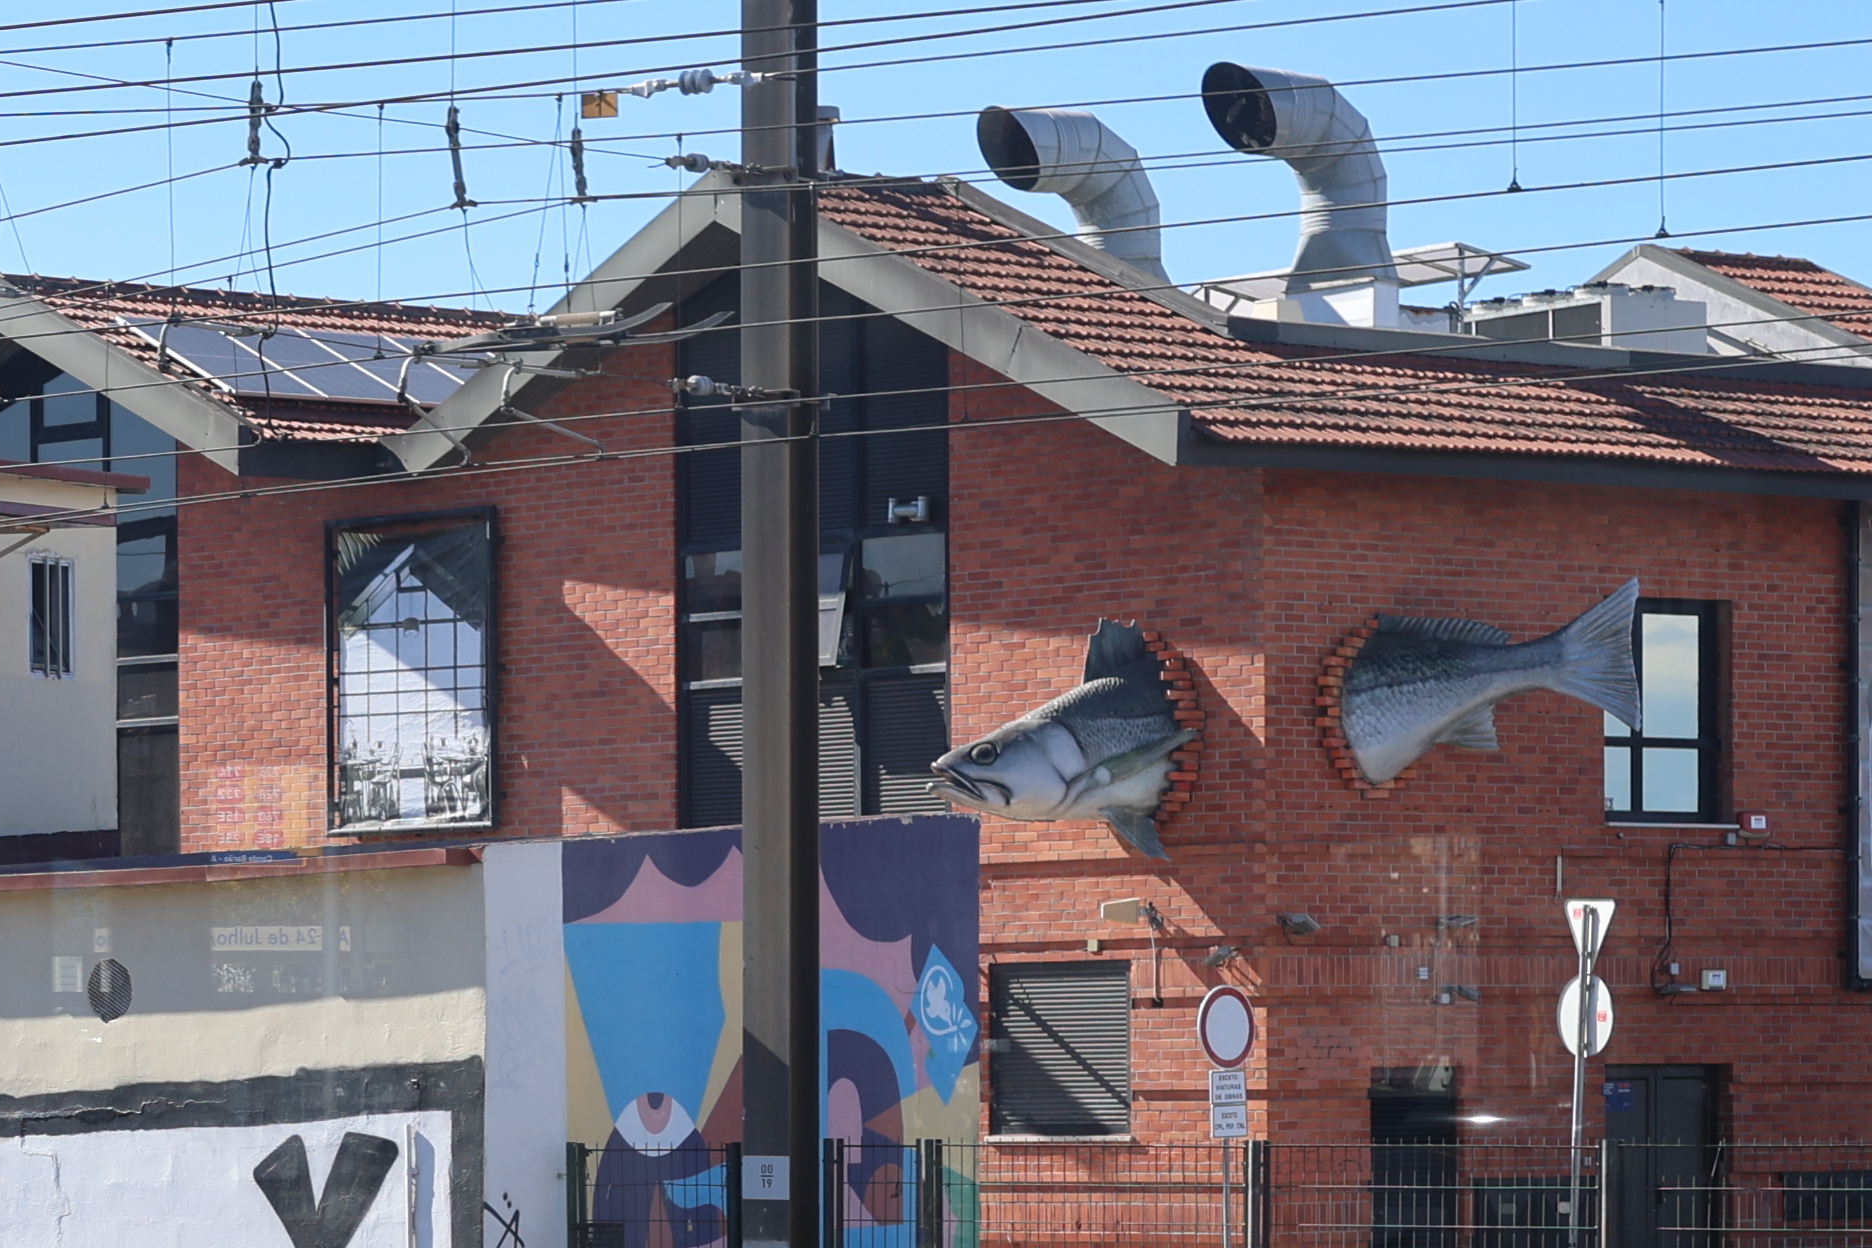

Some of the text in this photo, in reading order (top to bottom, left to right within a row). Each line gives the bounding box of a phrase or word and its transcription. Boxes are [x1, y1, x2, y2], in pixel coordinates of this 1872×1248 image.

[1215, 1083, 1241, 1091] VIATURAS
[761, 1164, 773, 1174] 00
[761, 1178, 773, 1189] 19
